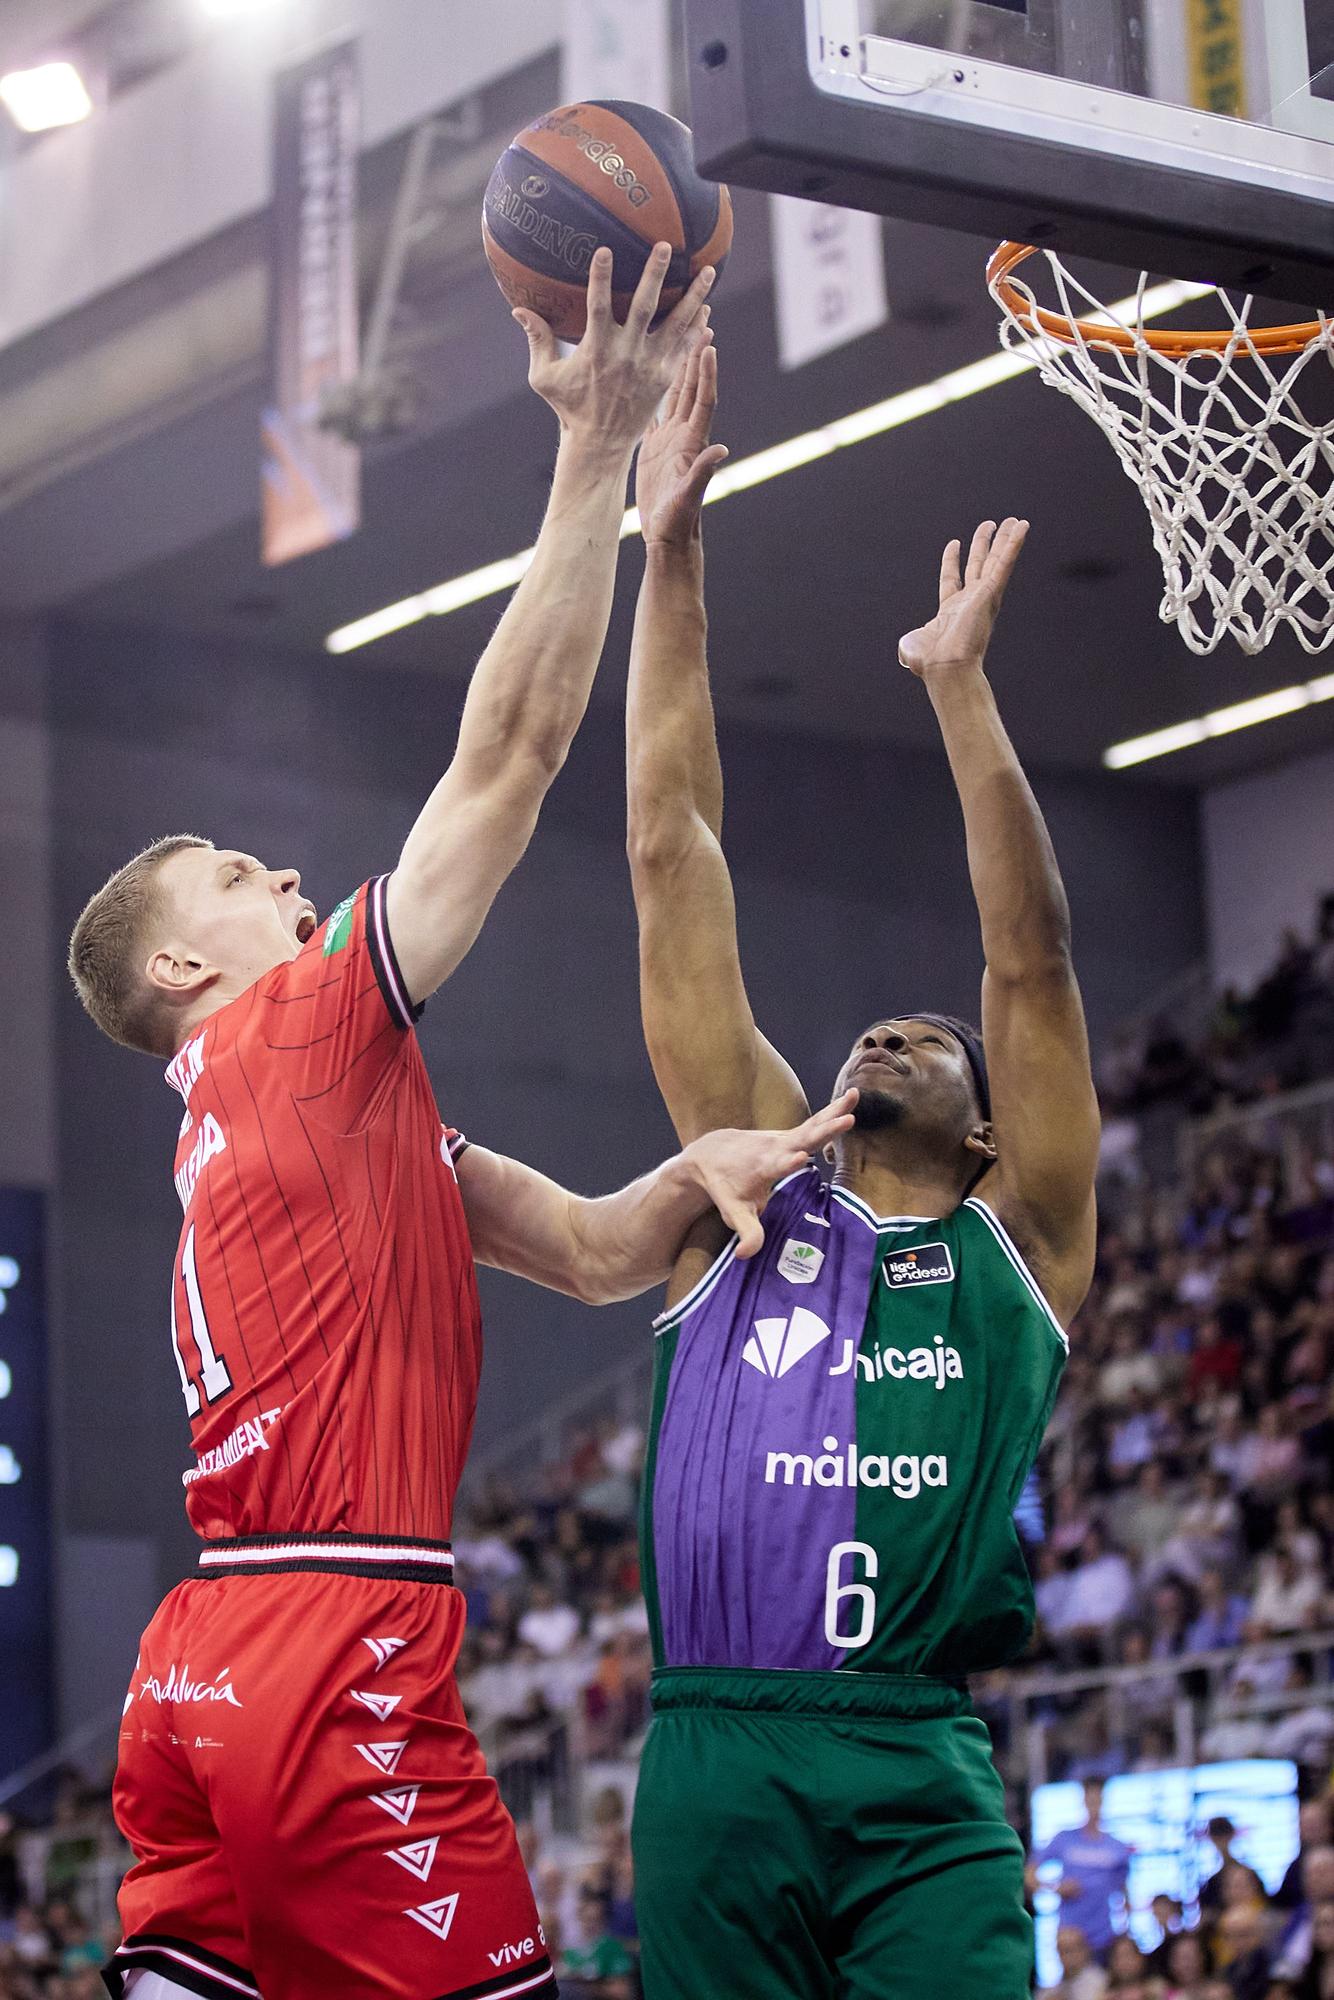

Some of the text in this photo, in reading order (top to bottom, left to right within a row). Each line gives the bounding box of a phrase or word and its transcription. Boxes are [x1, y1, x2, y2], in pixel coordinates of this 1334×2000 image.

[889, 1260, 917, 1274] liga
[892, 1266, 949, 1283] endesa
[825, 1541, 878, 1648] 6
[139, 1663, 243, 1708] Andalucía
[487, 1937, 535, 1967] vive
